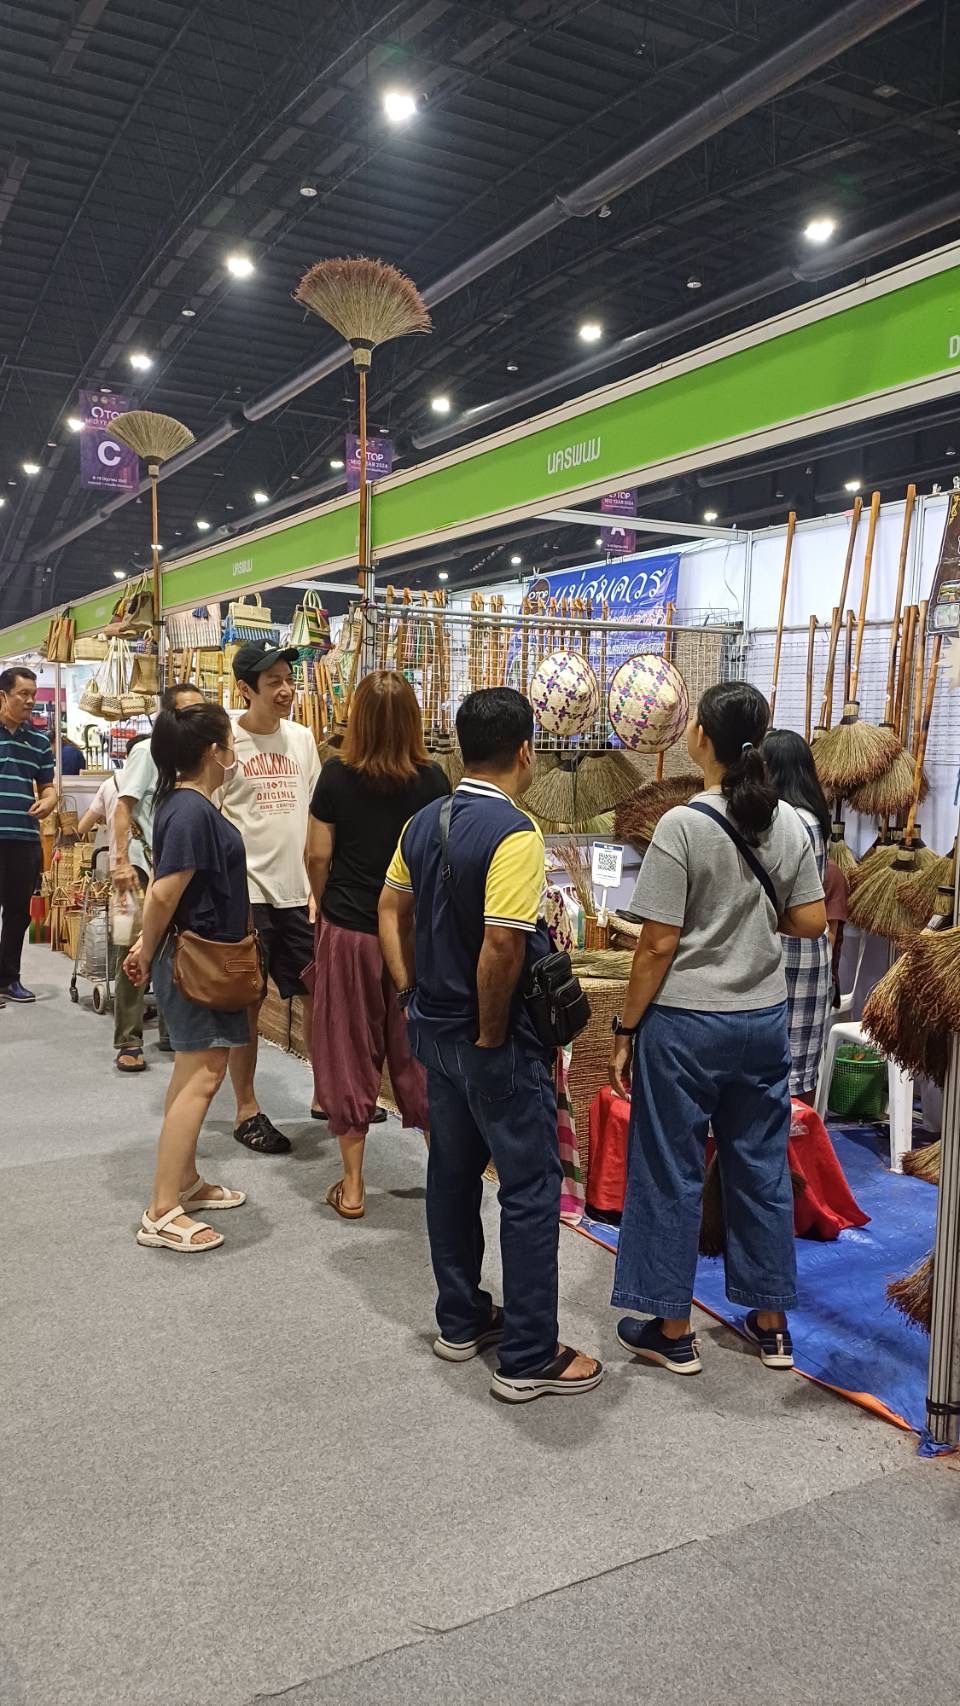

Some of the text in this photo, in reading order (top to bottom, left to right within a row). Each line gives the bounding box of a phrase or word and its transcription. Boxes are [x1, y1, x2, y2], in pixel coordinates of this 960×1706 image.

[91, 406, 125, 421] OTO
[97, 440, 121, 467] C
[547, 436, 601, 475] นครพนม
[528, 589, 549, 600] OTOP
